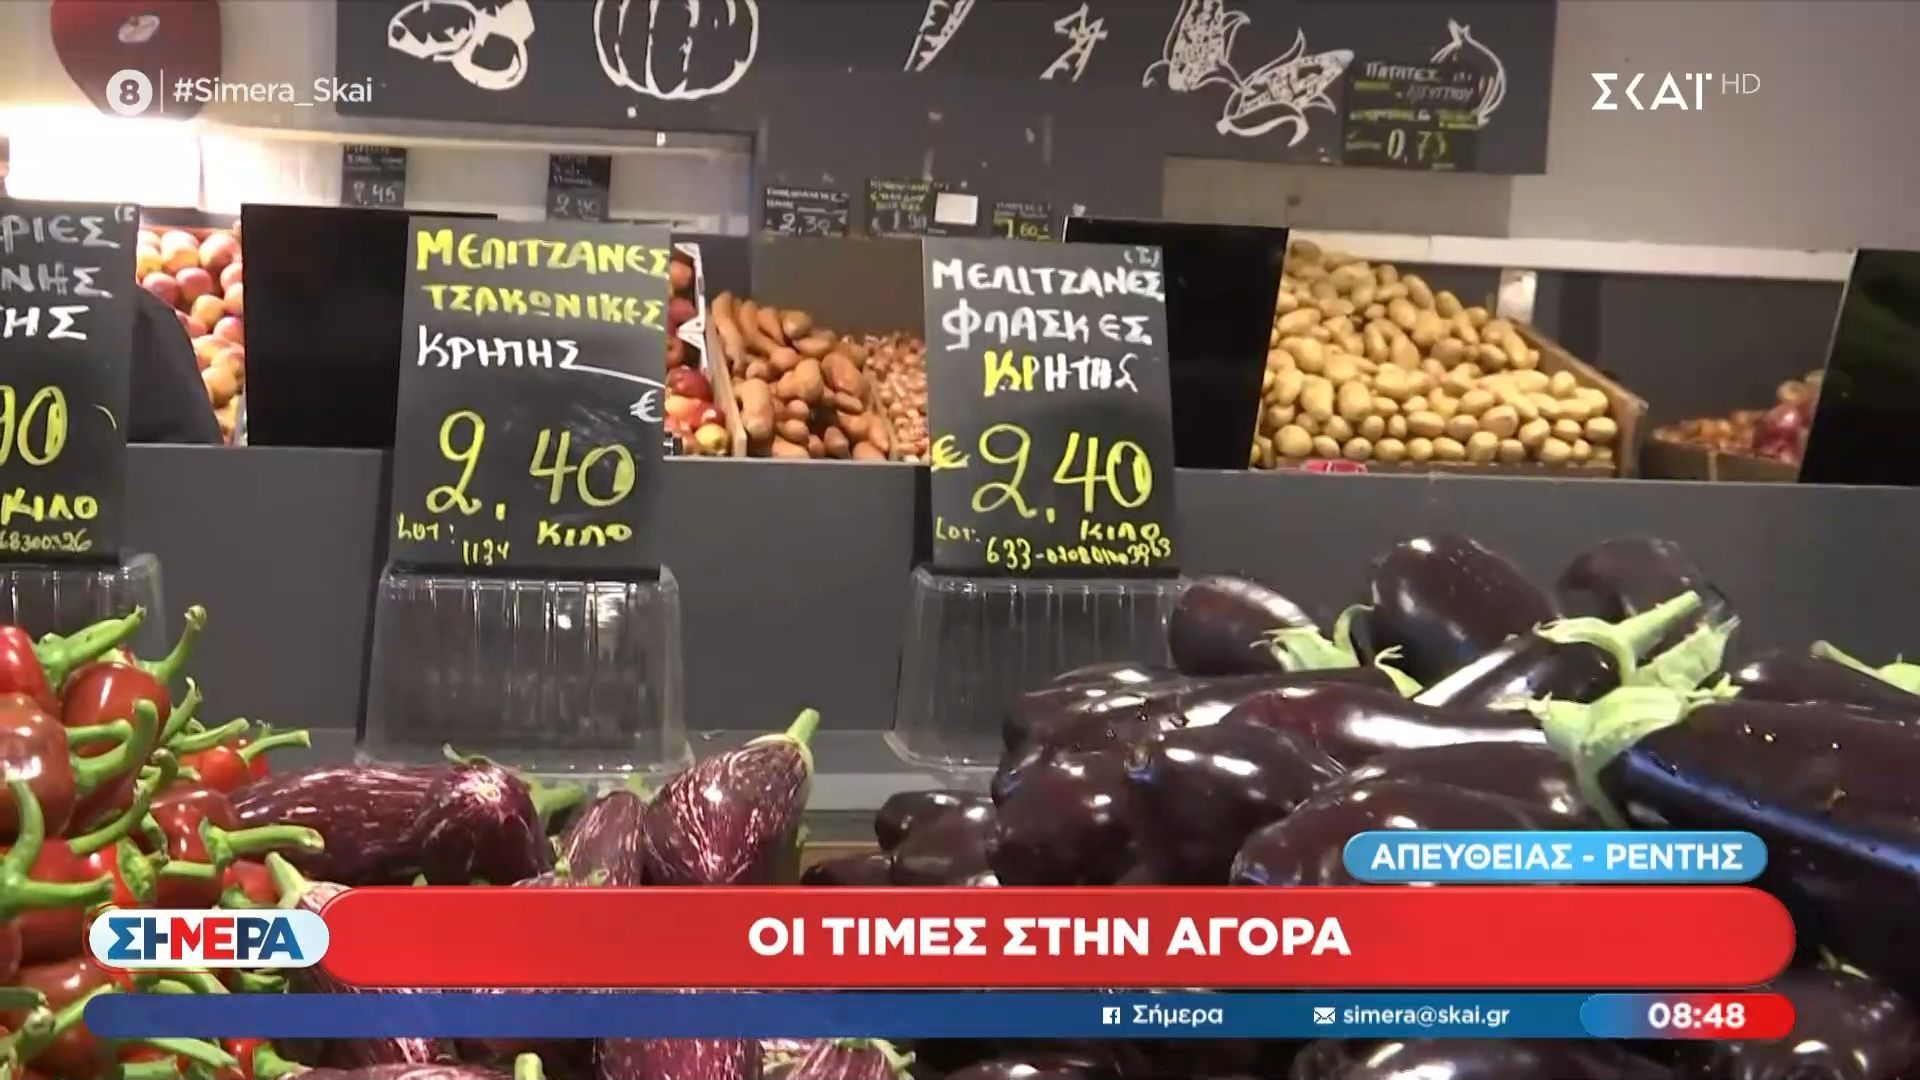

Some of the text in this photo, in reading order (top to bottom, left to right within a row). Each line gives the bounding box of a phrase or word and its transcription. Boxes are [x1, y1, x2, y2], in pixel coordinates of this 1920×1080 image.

[0, 214, 120, 254] ΡΙΕΣ
[416, 228, 671, 280] ΜΕΛΙΤΖΑΝΕΣ
[932, 258, 1166, 302] ΜΕΛΙΤΖΑΝΕΣ
[0, 305, 90, 340] ΗΣ
